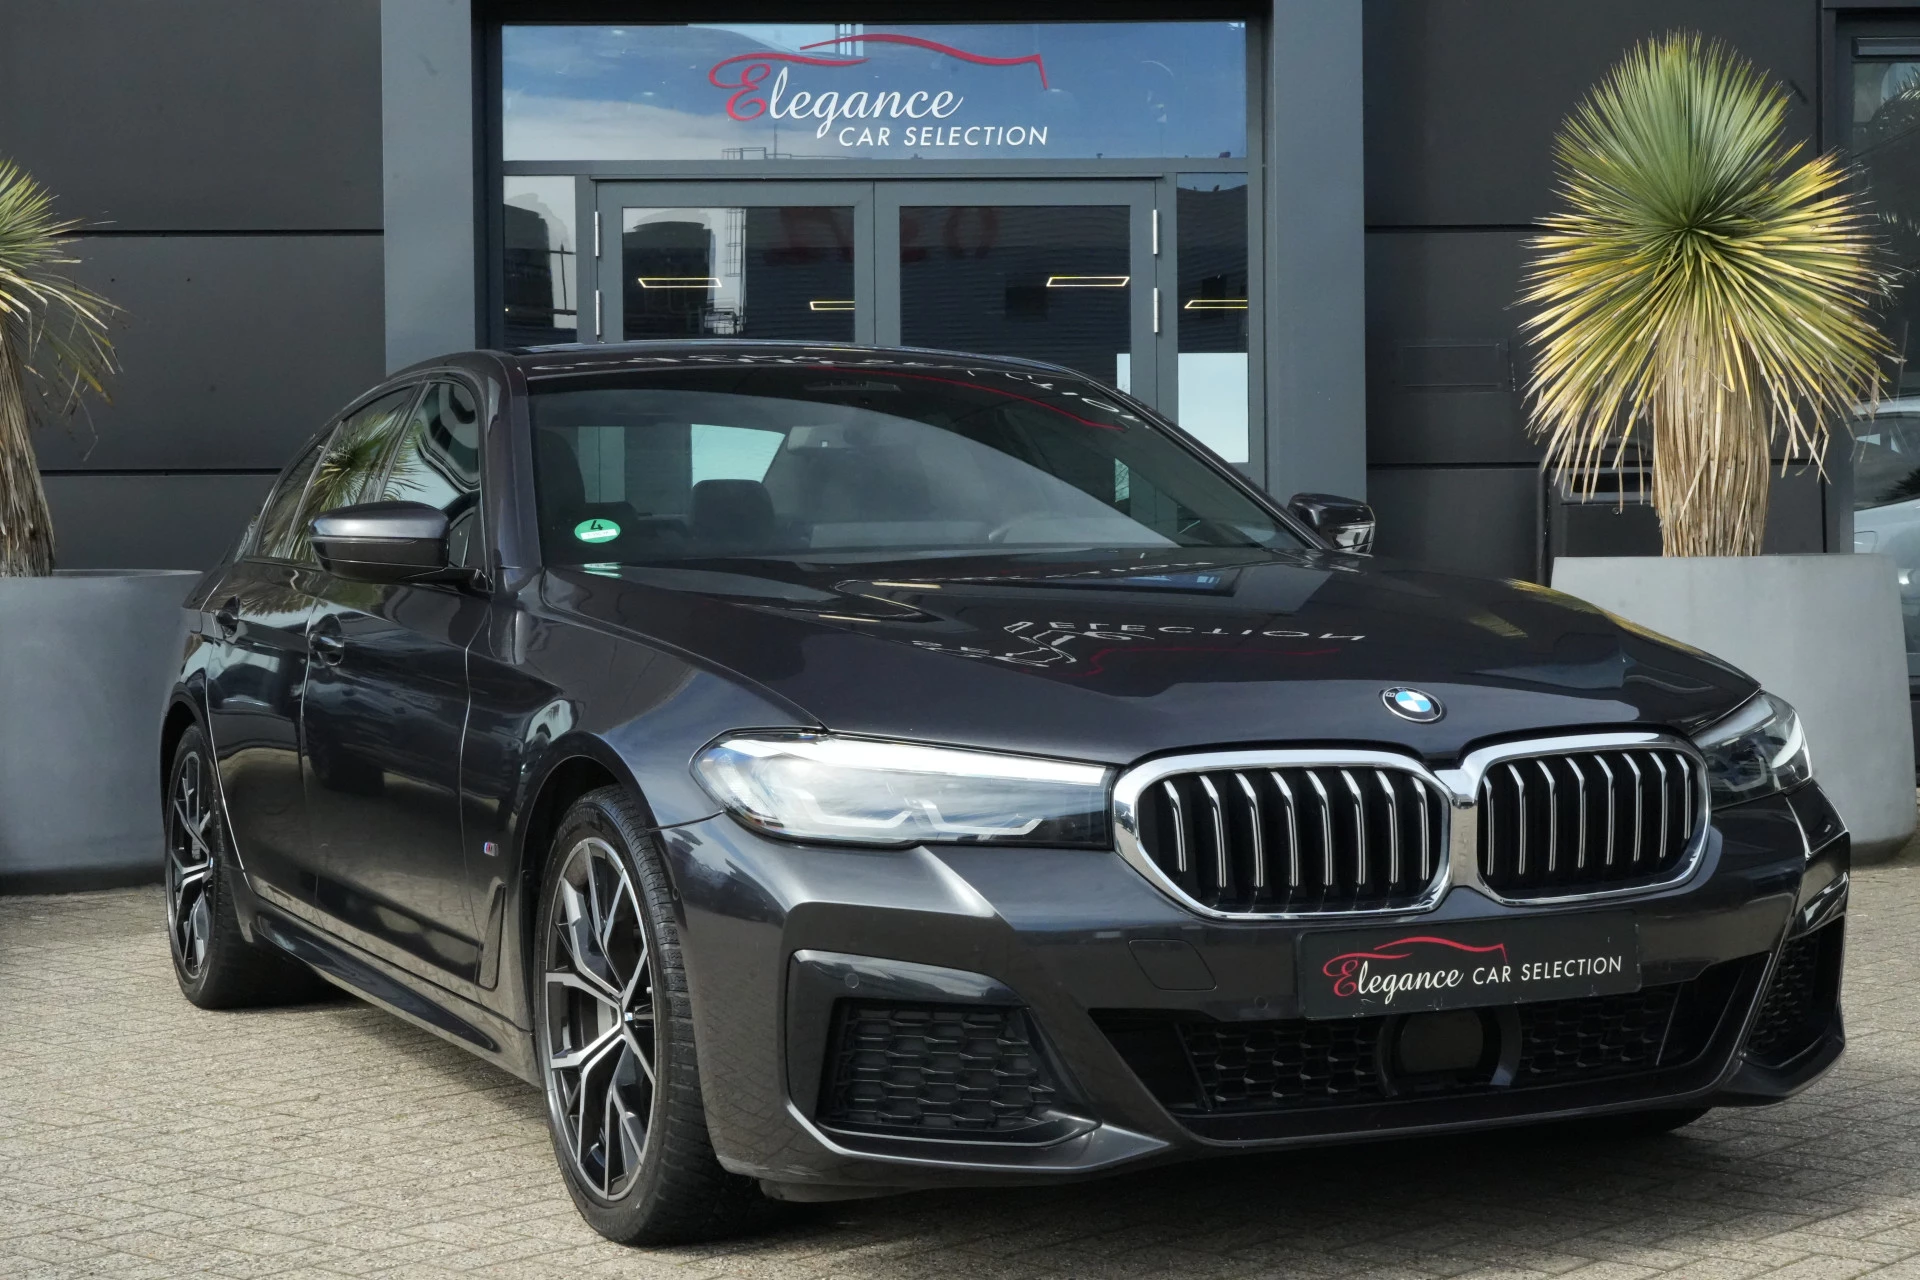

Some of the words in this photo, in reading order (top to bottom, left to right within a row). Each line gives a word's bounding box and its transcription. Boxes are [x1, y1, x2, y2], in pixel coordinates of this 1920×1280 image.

[709, 53, 964, 139] Elegance
[838, 127, 891, 147] CAR
[903, 126, 1048, 147] SELECTION
[1322, 951, 1464, 1005] Elegance
[1472, 966, 1512, 986] CAR
[1520, 955, 1623, 982] SELECTION
